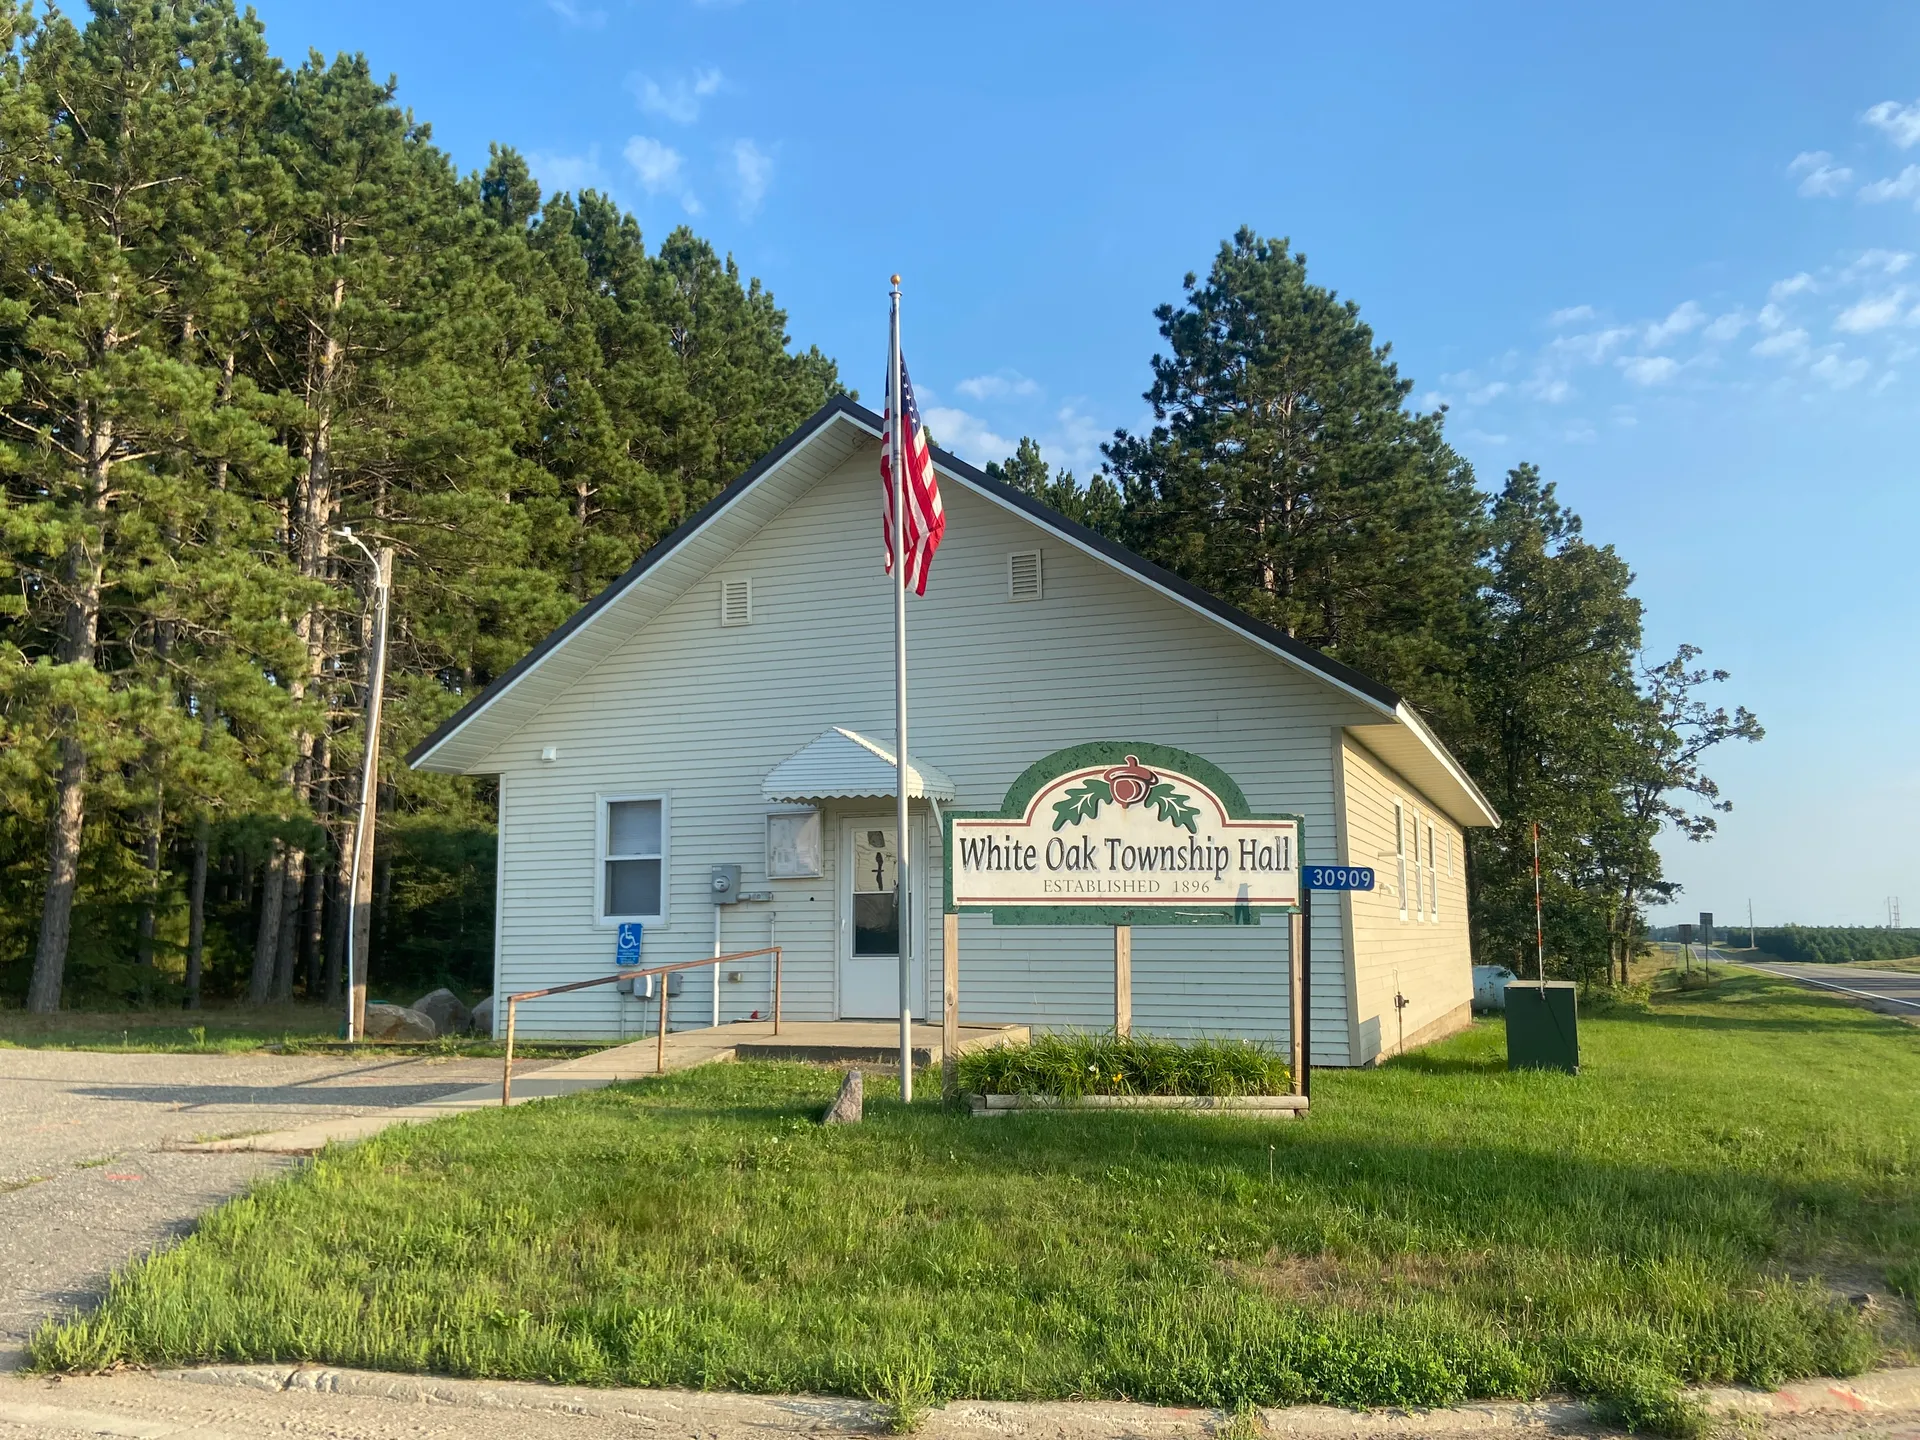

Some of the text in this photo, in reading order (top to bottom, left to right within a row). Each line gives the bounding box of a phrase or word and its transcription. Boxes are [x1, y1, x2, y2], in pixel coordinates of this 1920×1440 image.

[959, 834, 1290, 881] White Oak Township Hall
[1043, 879, 1210, 893] ESTABLISHED 1896
[1312, 868, 1371, 887] 30909
